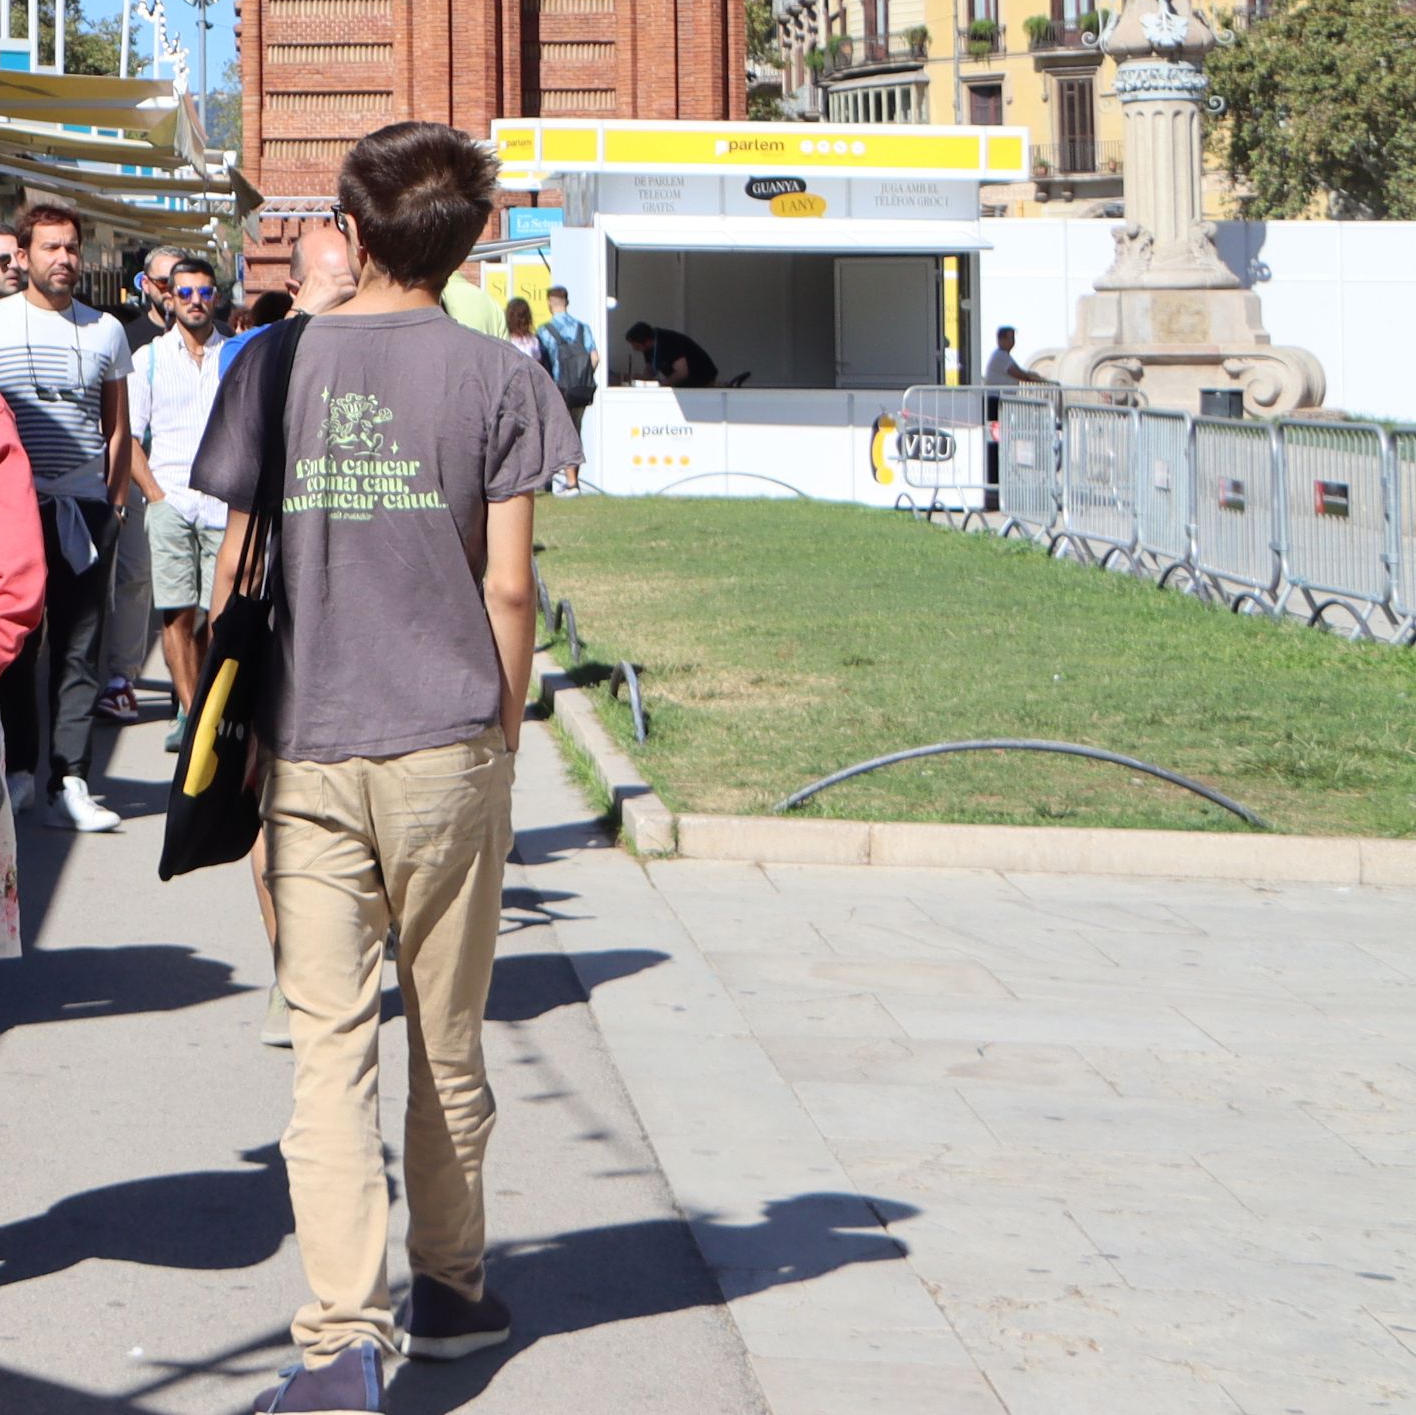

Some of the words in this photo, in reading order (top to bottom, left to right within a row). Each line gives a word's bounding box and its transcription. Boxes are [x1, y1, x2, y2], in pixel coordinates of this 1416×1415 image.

[729, 138, 785, 153] parlem
[634, 176, 646, 186] DE
[649, 176, 684, 187] PARLEM
[751, 180, 801, 193] GUANYA
[638, 189, 681, 200] TELECOM
[788, 199, 817, 213] ANY
[642, 424, 693, 439] parlem
[905, 434, 953, 458] VEU
[341, 459, 420, 476] caucar
[307, 476, 357, 492] coma
[362, 476, 410, 493] cau,
